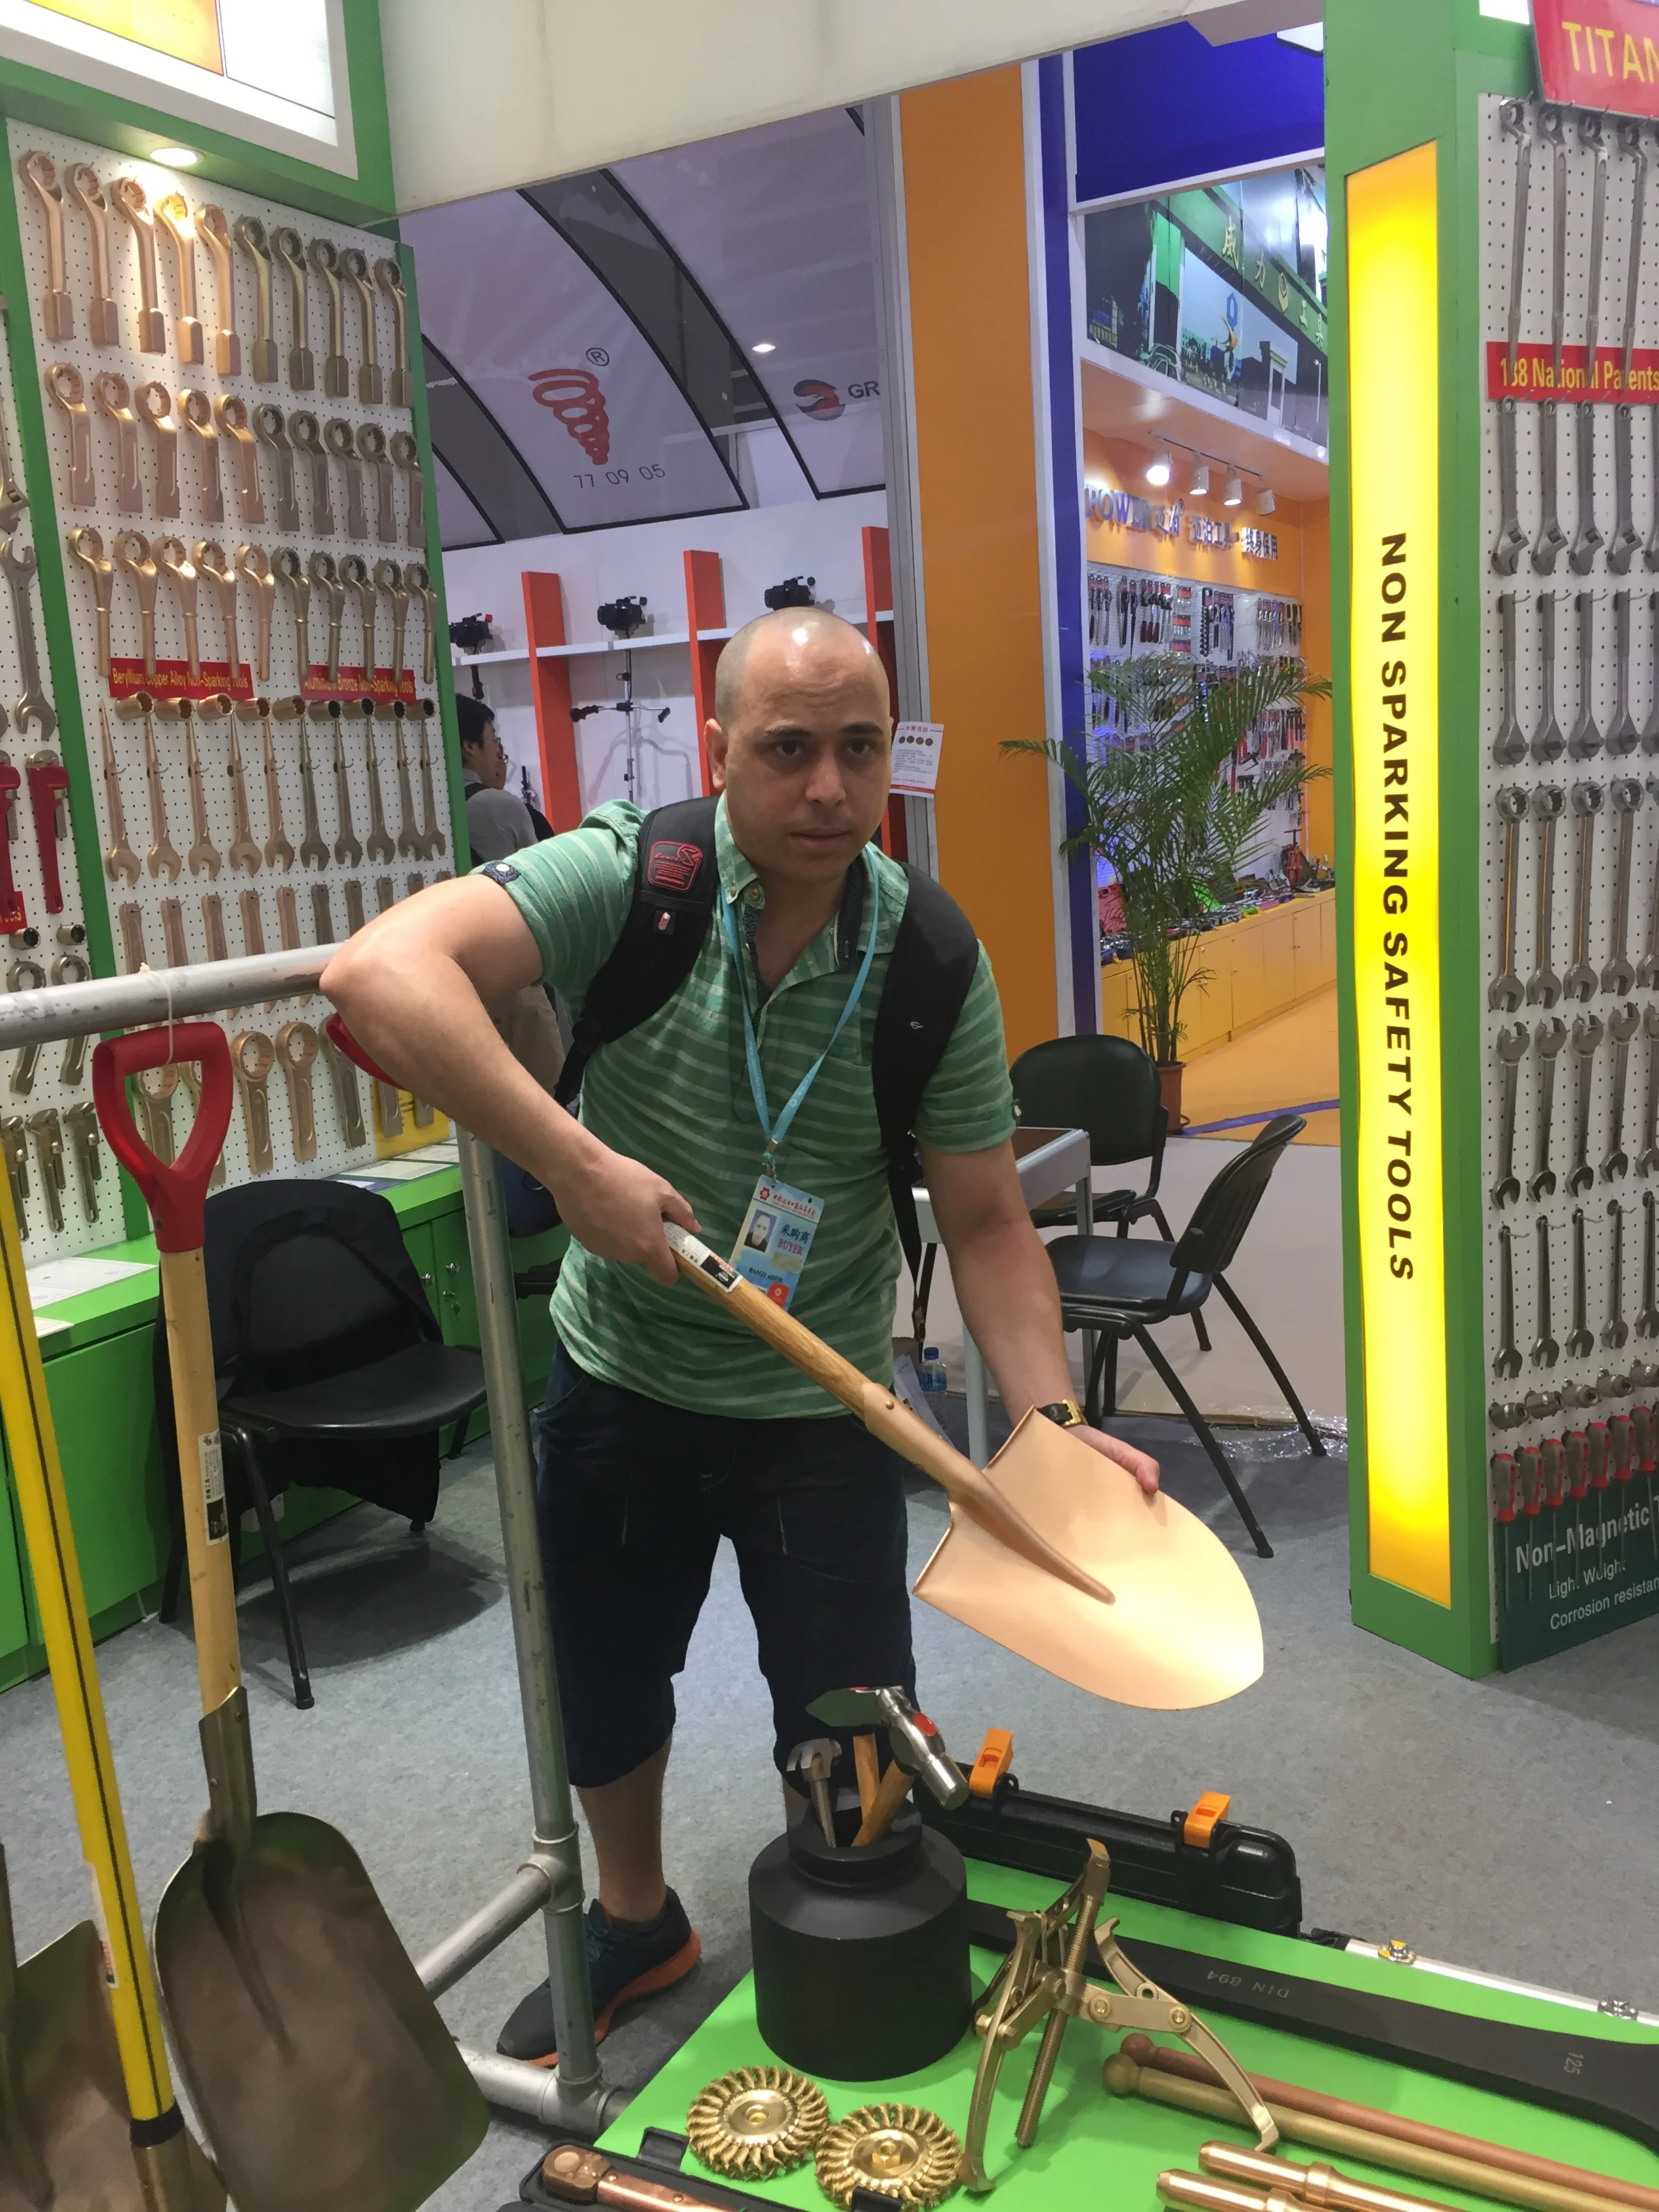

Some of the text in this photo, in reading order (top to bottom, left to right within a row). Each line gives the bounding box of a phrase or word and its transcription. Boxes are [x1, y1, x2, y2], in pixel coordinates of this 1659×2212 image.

[1561, 21, 1659, 84] TITAN
[1532, 358, 1599, 389] Naionl
[1604, 361, 1659, 391] Paents
[848, 381, 880, 398] GR
[574, 464, 665, 488] 77 09 05
[1381, 533, 1414, 1280] NON SPARKING SAFETY TOOLS
[777, 1238, 803, 1255] BUYER
[1549, 1576, 1580, 1599] Ligh
[1550, 1596, 1610, 1630] Corrosion
[1252, 1982, 1290, 1999] DIN
[1563, 2052, 1584, 2074] 125
